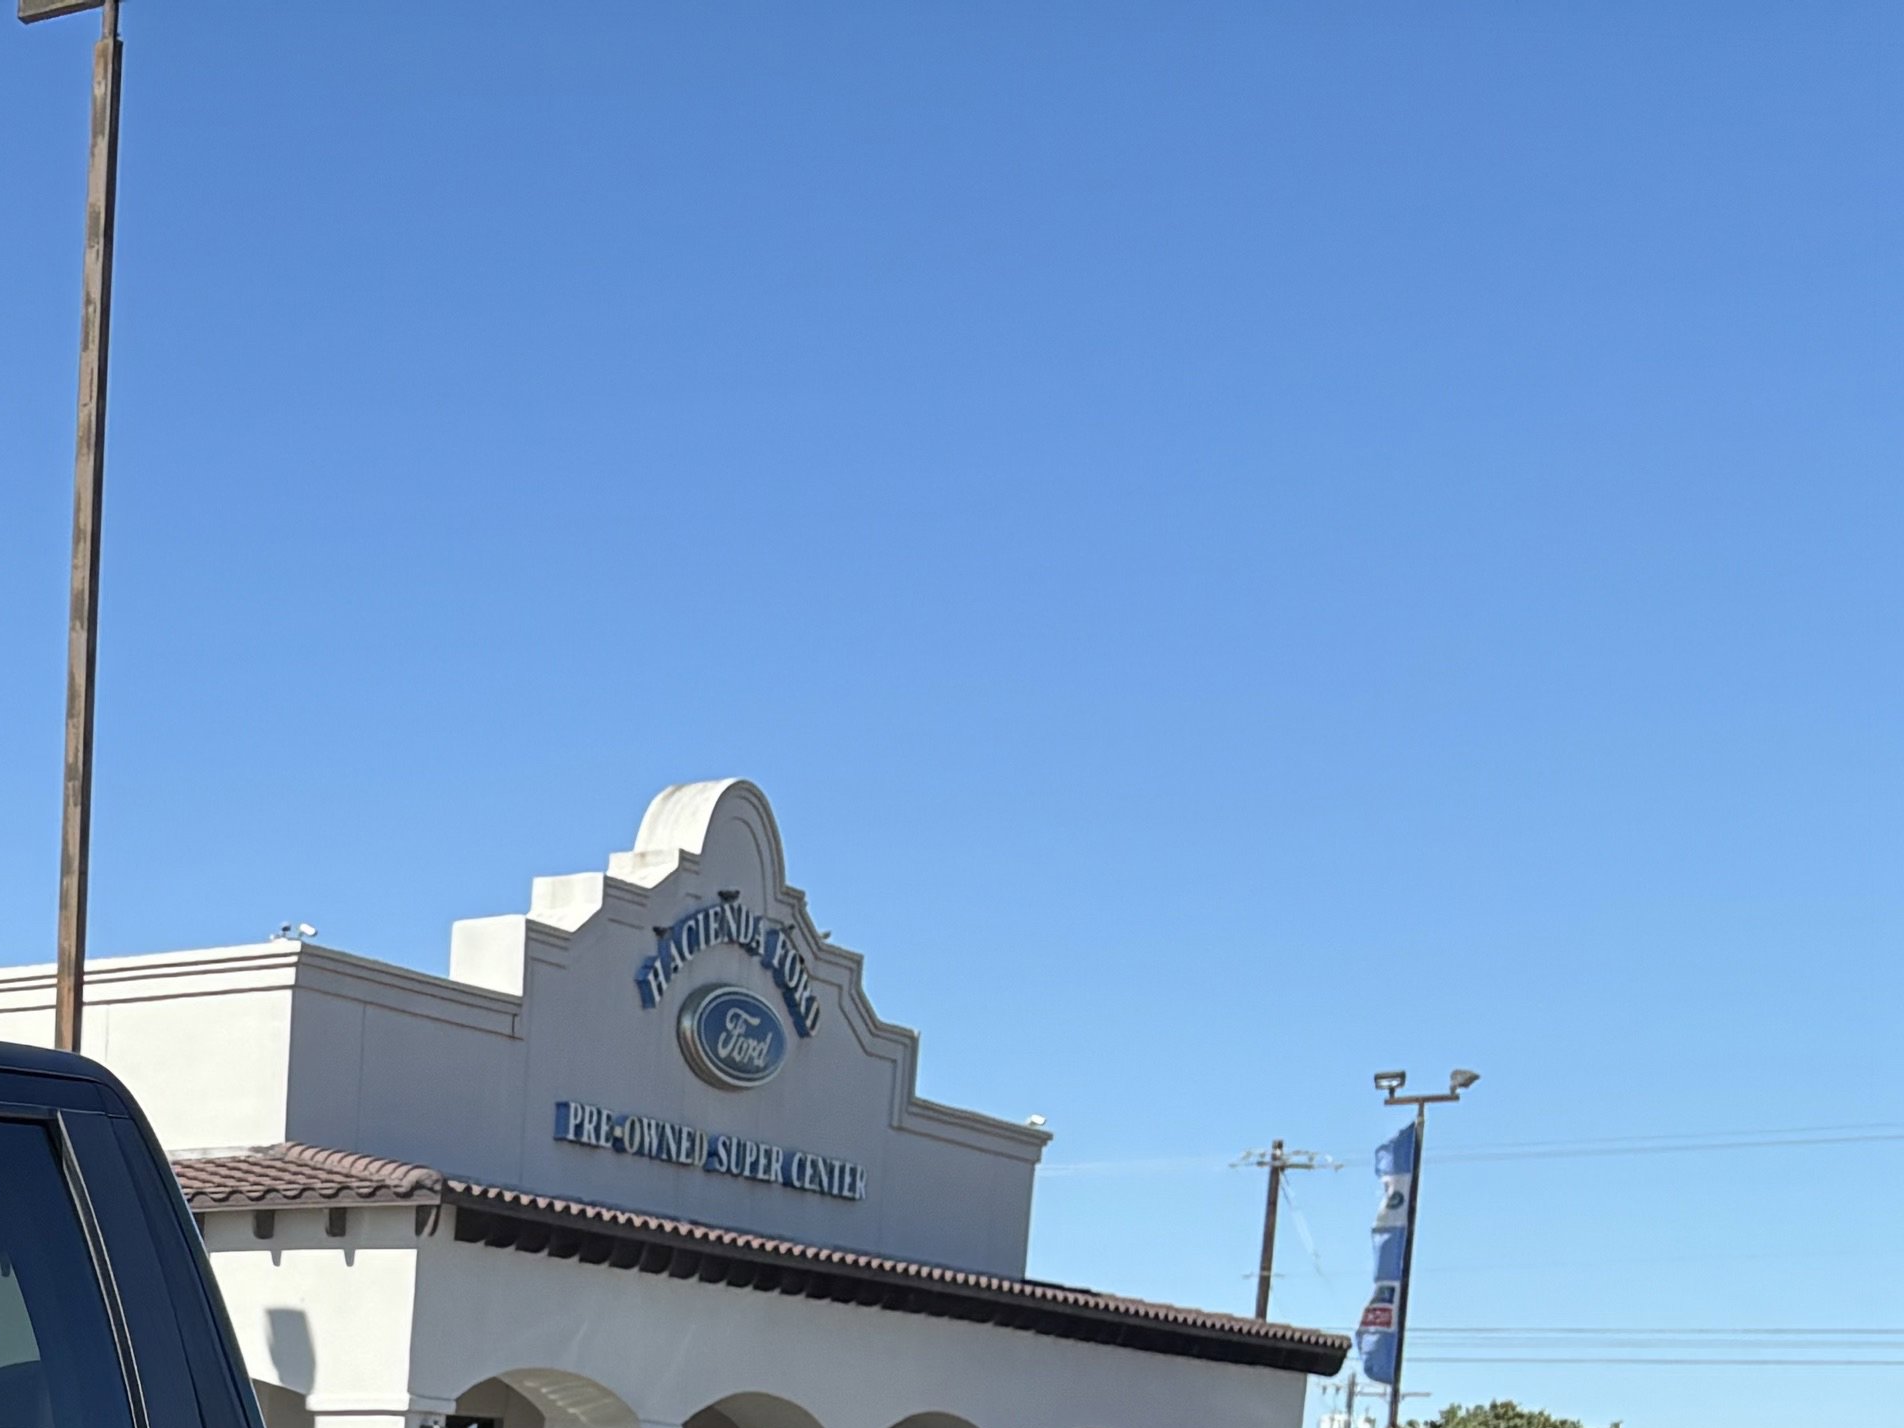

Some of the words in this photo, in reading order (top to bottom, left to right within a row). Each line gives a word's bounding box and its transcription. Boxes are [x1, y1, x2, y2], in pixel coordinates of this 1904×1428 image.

[647, 901, 767, 1004] HACIENDA
[772, 931, 820, 1037] FORD
[717, 1007, 773, 1068] Ford
[565, 1100, 709, 1167] PRE-OWNED
[715, 1135, 784, 1185] SUPER
[792, 1151, 868, 1200] CENTER
